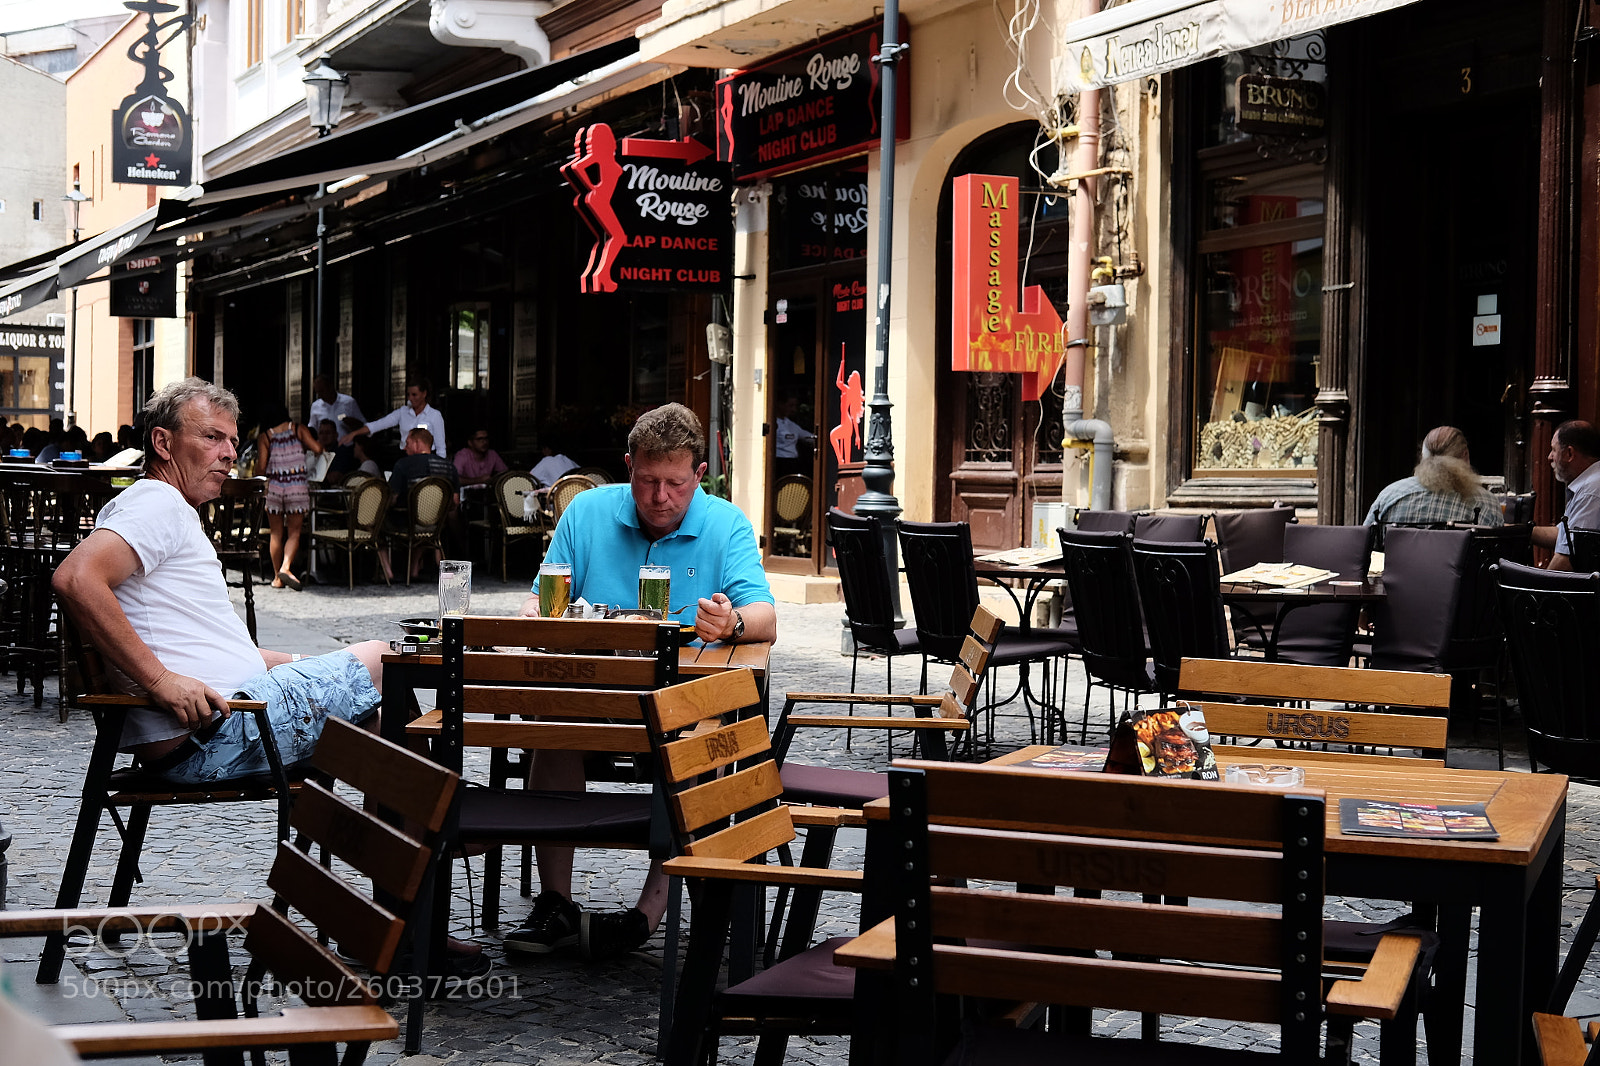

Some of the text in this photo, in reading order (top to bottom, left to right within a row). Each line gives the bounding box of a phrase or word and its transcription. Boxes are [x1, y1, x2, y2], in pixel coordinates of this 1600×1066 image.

[1104, 35, 1154, 78] Nenea
[738, 53, 861, 117] Mouline Rouge
[1461, 67, 1471, 94] 3
[1246, 83, 1318, 110] BRUNO
[759, 95, 835, 136] LAP DANCE
[758, 124, 837, 163] NIGHT CLUB
[127, 166, 177, 180] Heineken
[622, 163, 723, 192] Mouline
[635, 191, 710, 226] Rouge
[624, 234, 719, 251] LAP DANCE
[981, 182, 1009, 332] Massage
[620, 266, 721, 283] NIGHT CLUB
[0, 332, 37, 350] LIQUOR
[39, 334, 46, 348] &
[1015, 331, 1063, 353] FIRE
[523, 660, 598, 680] URSUS
[1266, 711, 1350, 739] URSUS
[705, 730, 740, 762] URSUS
[1202, 770, 1218, 780] RON
